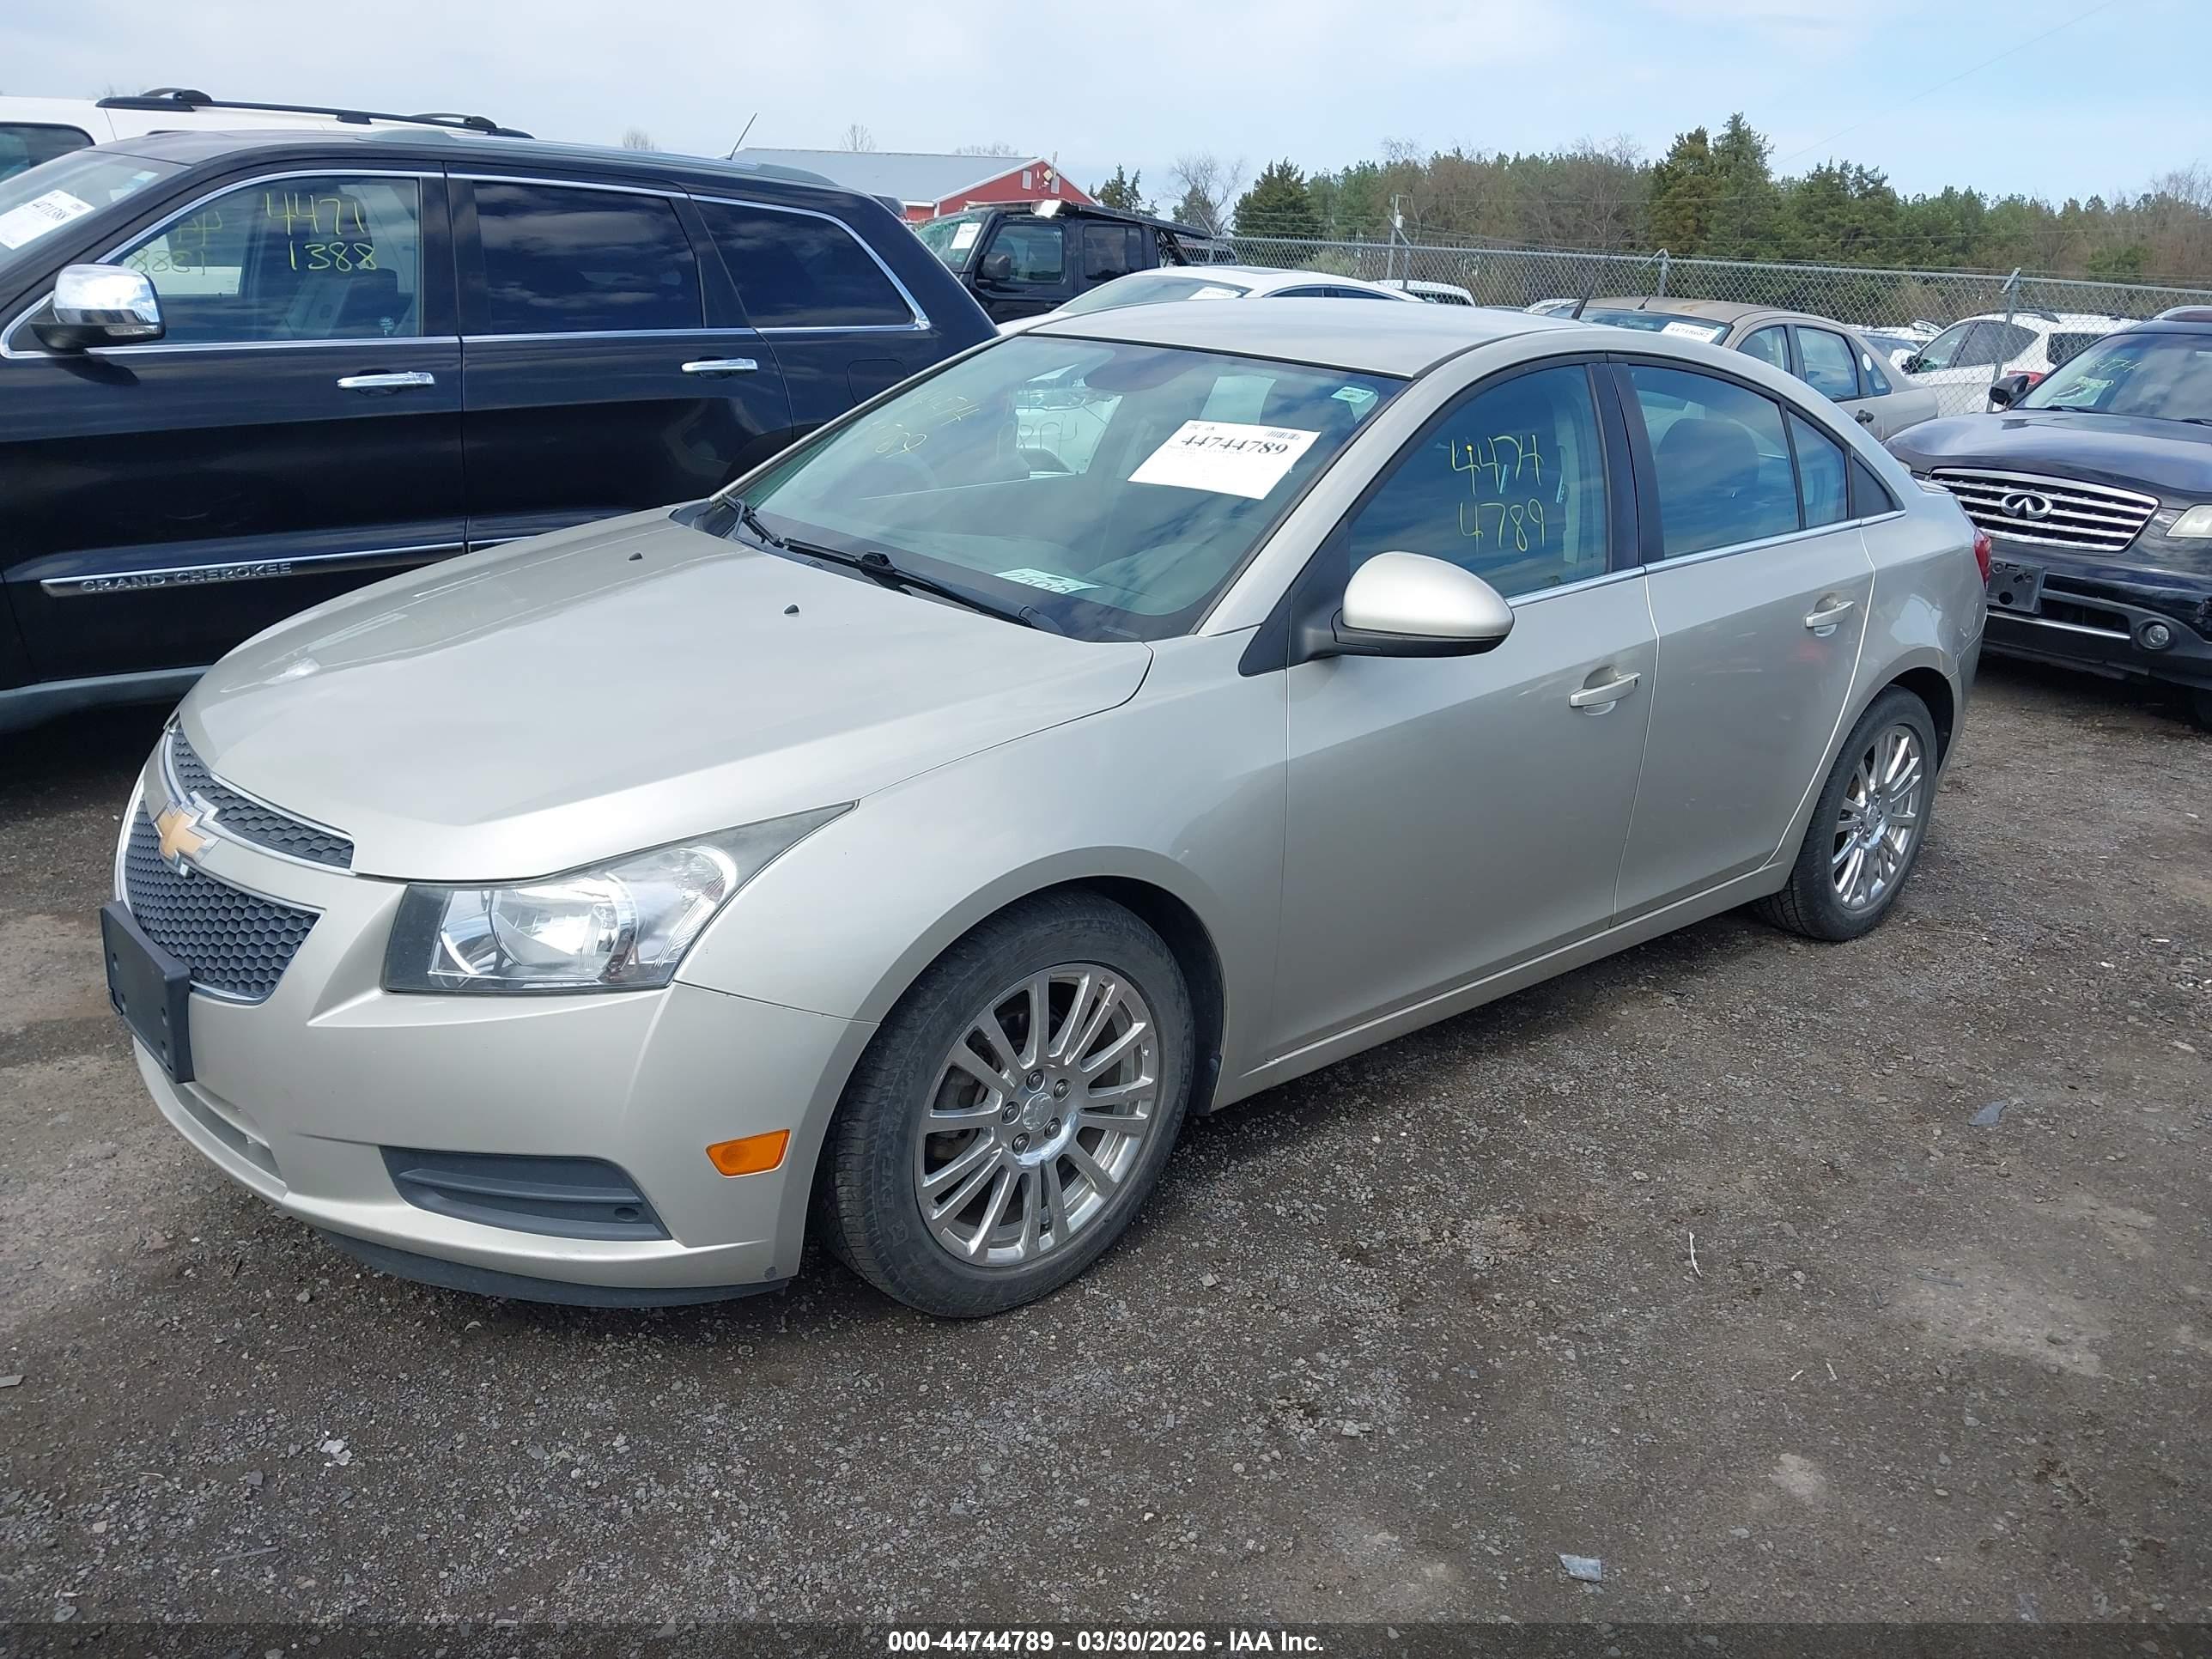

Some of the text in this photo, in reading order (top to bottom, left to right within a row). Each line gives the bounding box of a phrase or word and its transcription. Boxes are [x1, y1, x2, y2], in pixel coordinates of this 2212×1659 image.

[265, 191, 366, 236] 4471
[289, 240, 378, 272] 1388
[1181, 434, 1289, 455] 44744789
[1451, 434, 1545, 495] 4474
[1460, 498, 1545, 554] 4789
[80, 562, 293, 592] GRAND CHEROKEE
